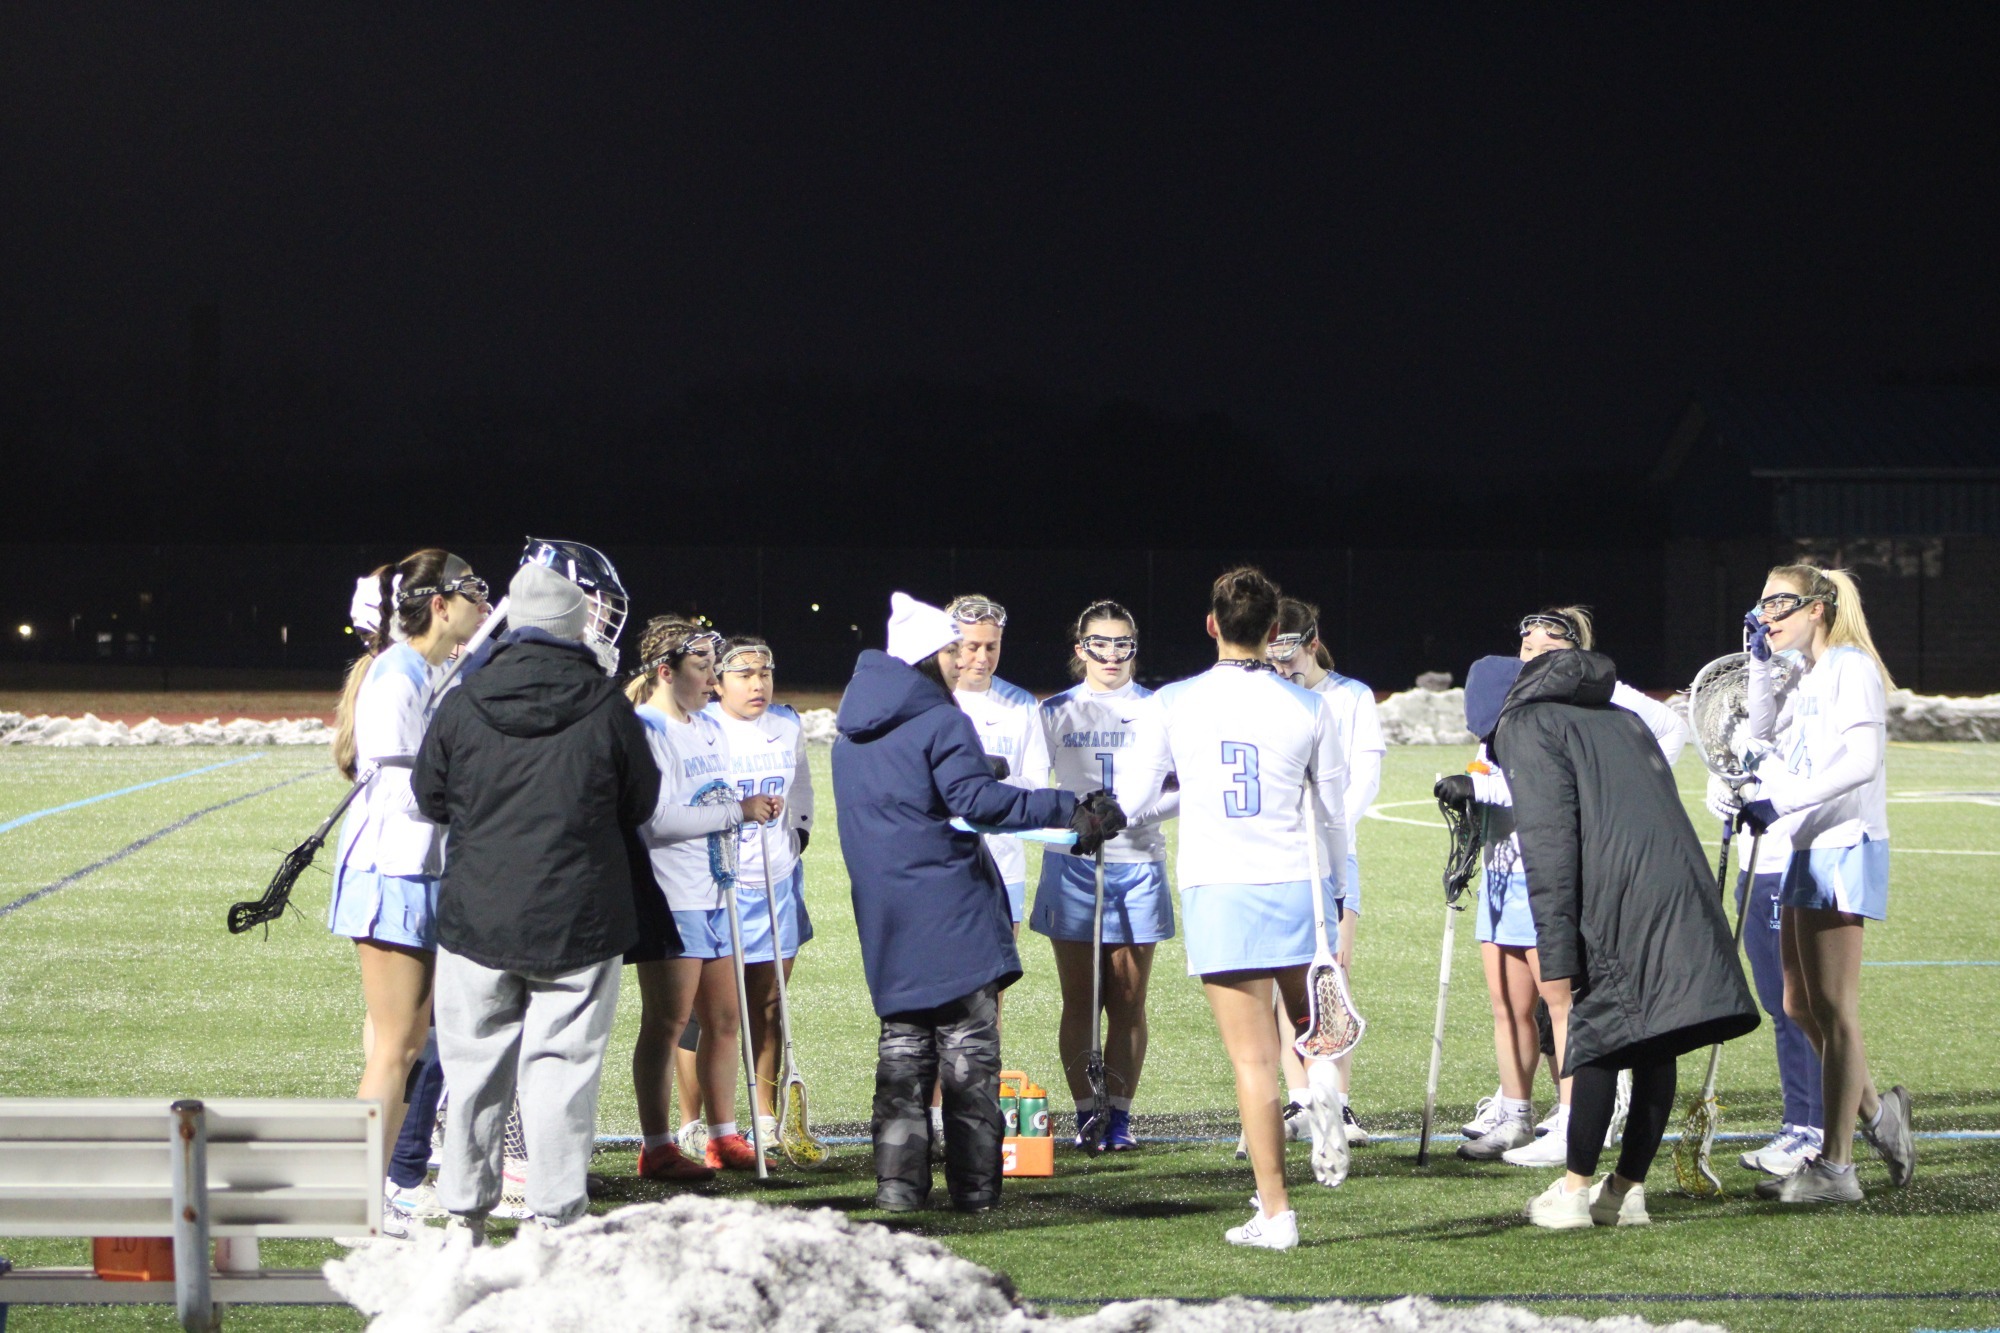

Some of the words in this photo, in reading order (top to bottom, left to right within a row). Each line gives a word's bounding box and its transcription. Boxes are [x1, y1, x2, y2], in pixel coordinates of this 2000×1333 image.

[414, 586, 438, 596] STX
[444, 583, 459, 592] ST
[1095, 752, 1118, 801] 1
[1220, 740, 1262, 819] 3
[1033, 1110, 1048, 1130] G
